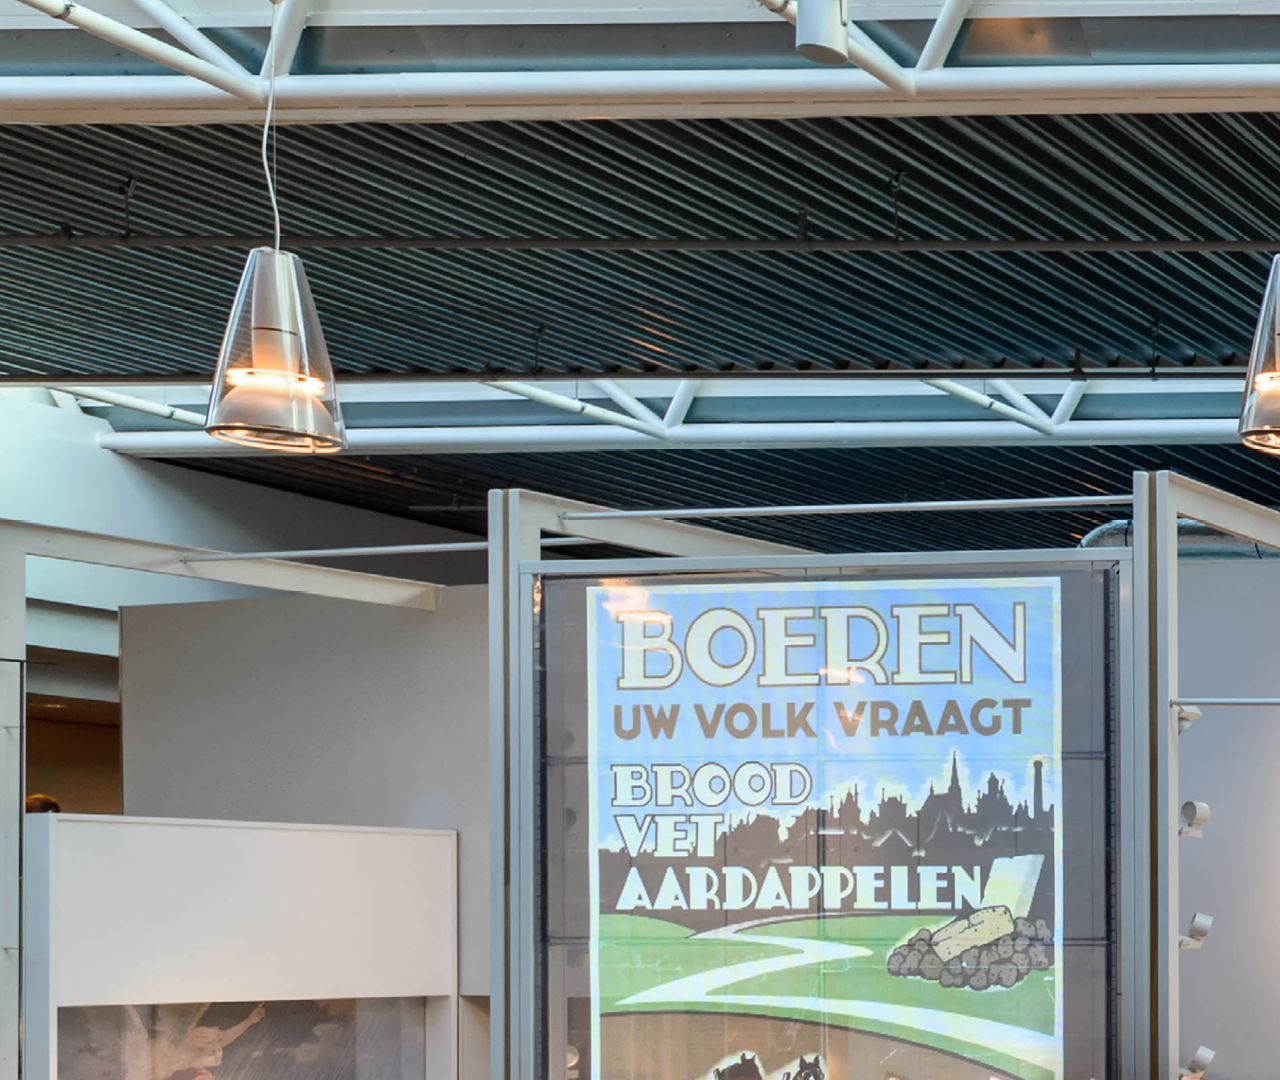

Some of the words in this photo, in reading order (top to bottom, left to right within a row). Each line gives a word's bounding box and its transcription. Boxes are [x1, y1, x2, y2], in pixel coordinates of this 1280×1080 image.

[617, 602, 1027, 689] BOEREN
[613, 705, 681, 740] UW
[695, 702, 817, 738] VOLK
[833, 698, 1032, 736] VRAAGT
[611, 761, 813, 808] BROOD
[614, 814, 724, 857] VET
[615, 866, 982, 910] AARDAPPELEN
